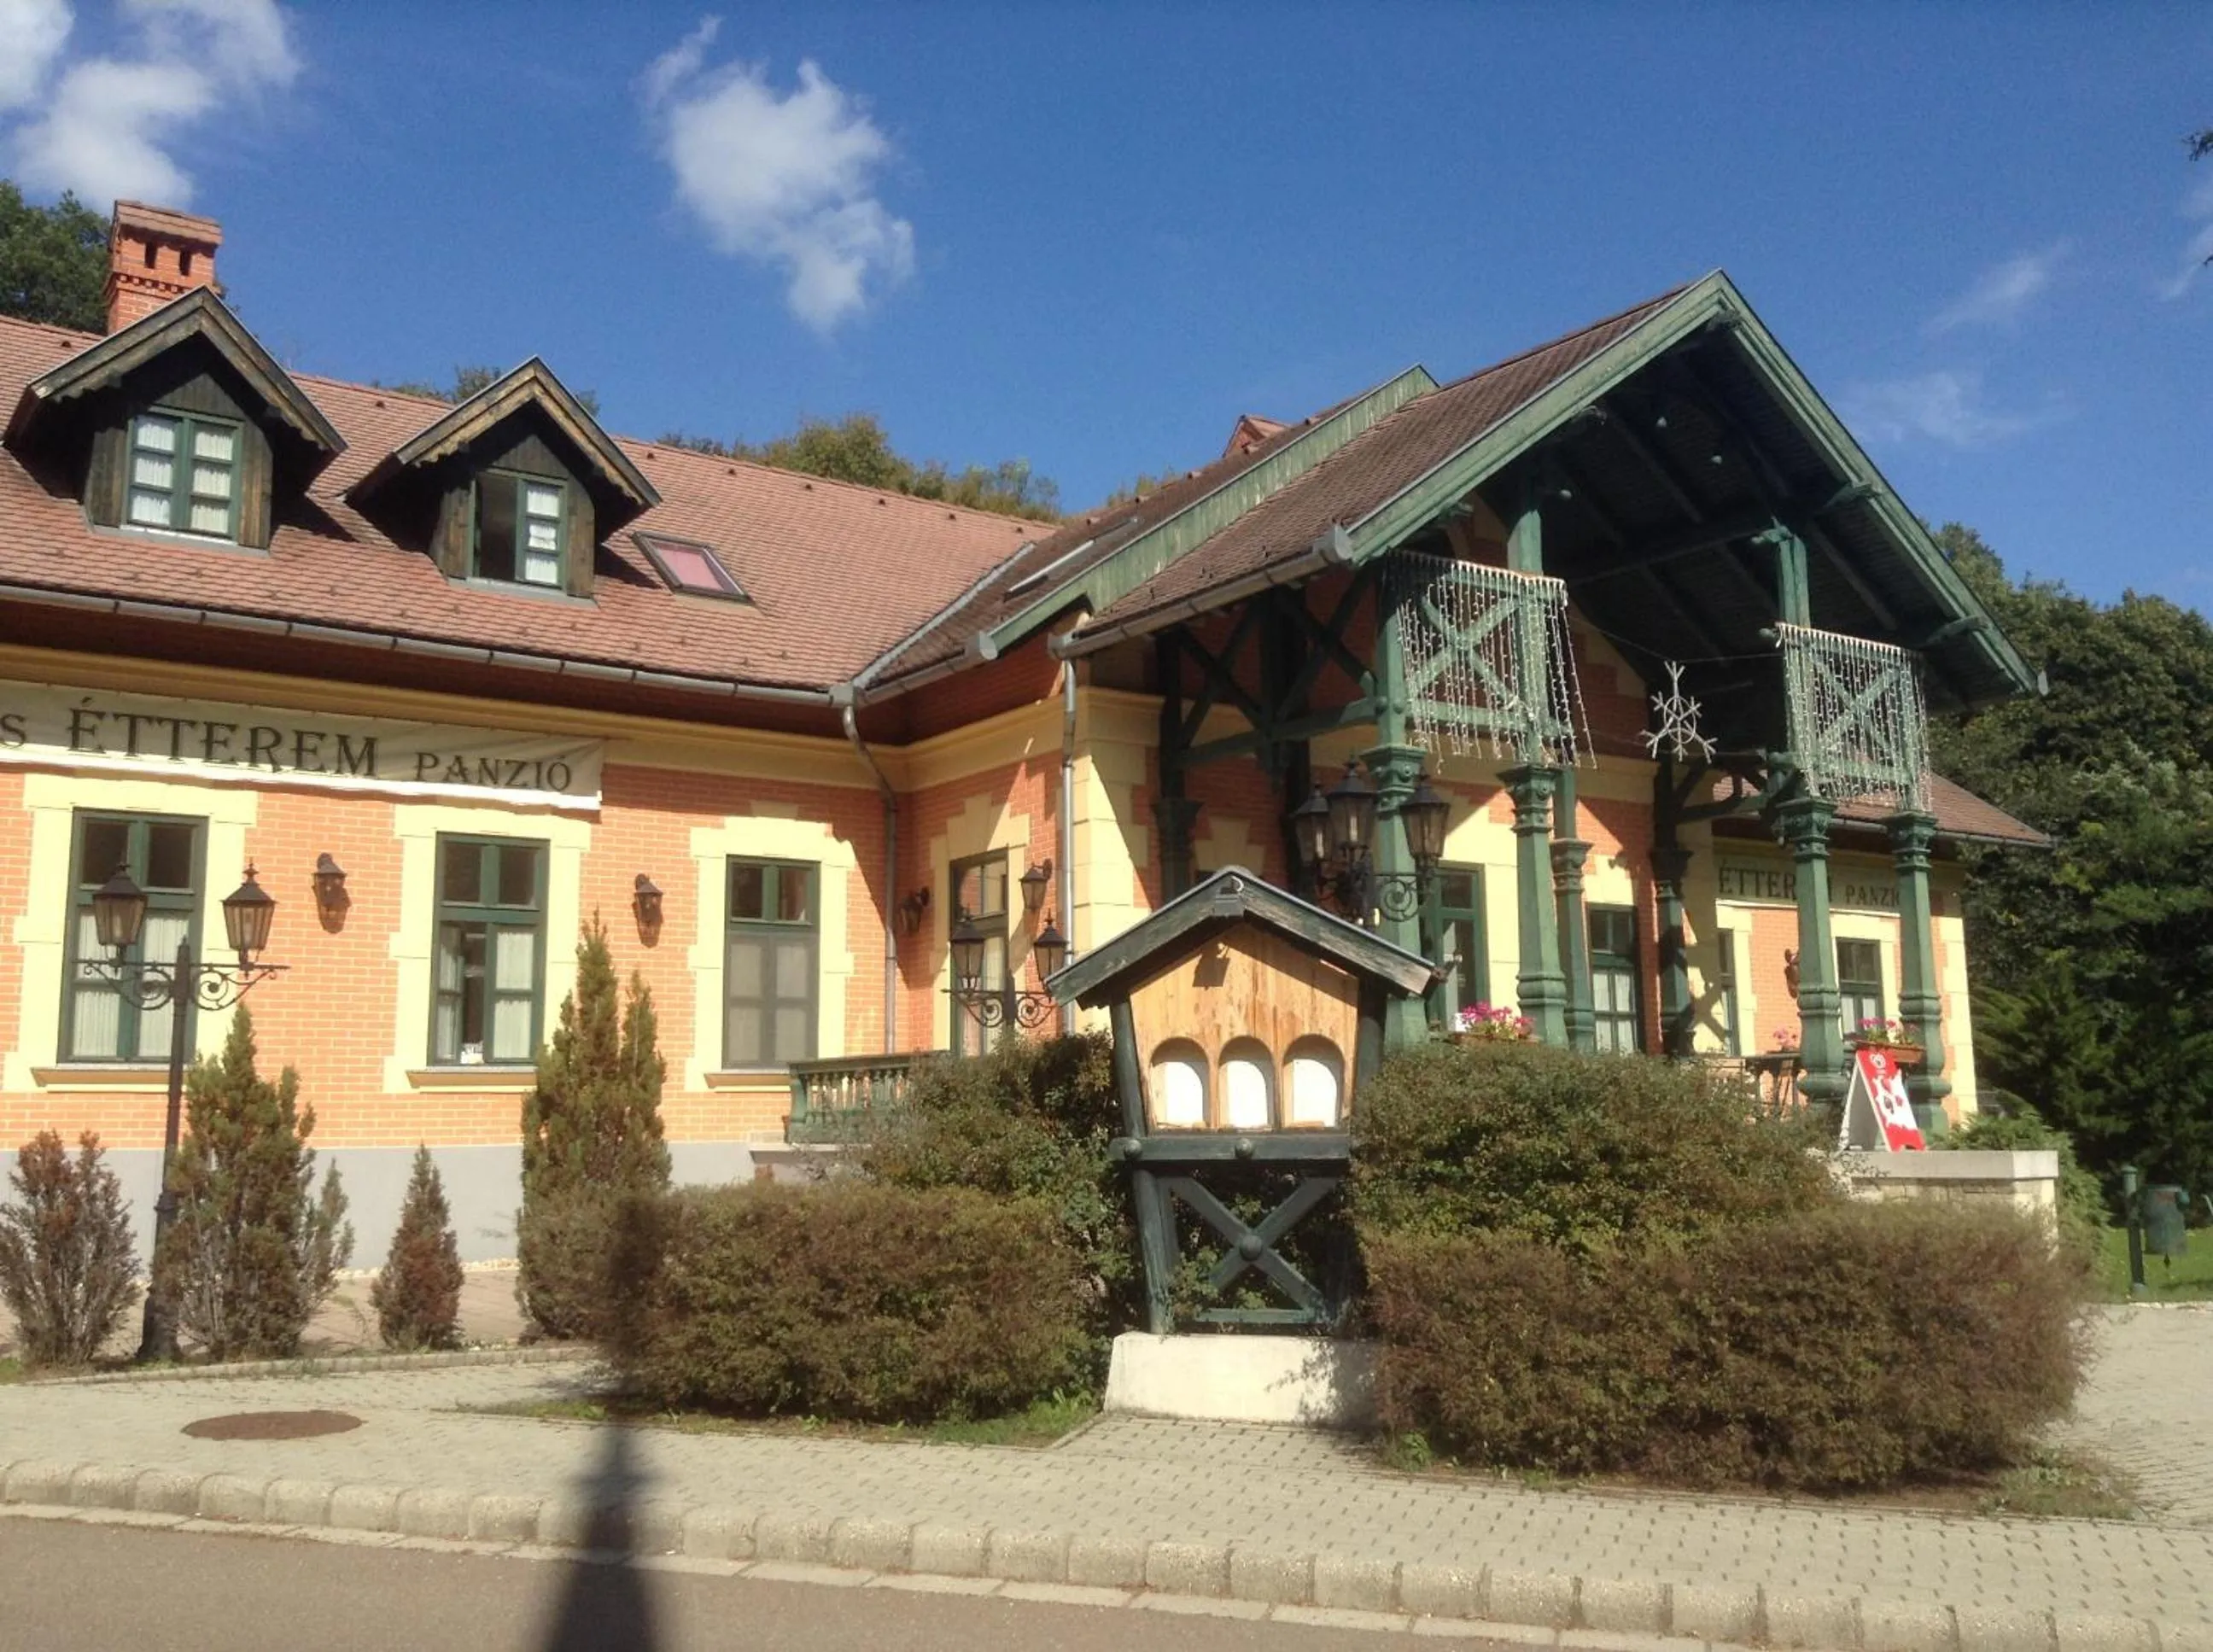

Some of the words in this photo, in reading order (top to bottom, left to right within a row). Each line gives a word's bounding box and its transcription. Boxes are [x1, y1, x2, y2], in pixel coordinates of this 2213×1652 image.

[66, 696, 379, 778] ÉTTEREM
[414, 751, 572, 792] PANZIÓ
[1719, 858, 1832, 902] ÉTTER
